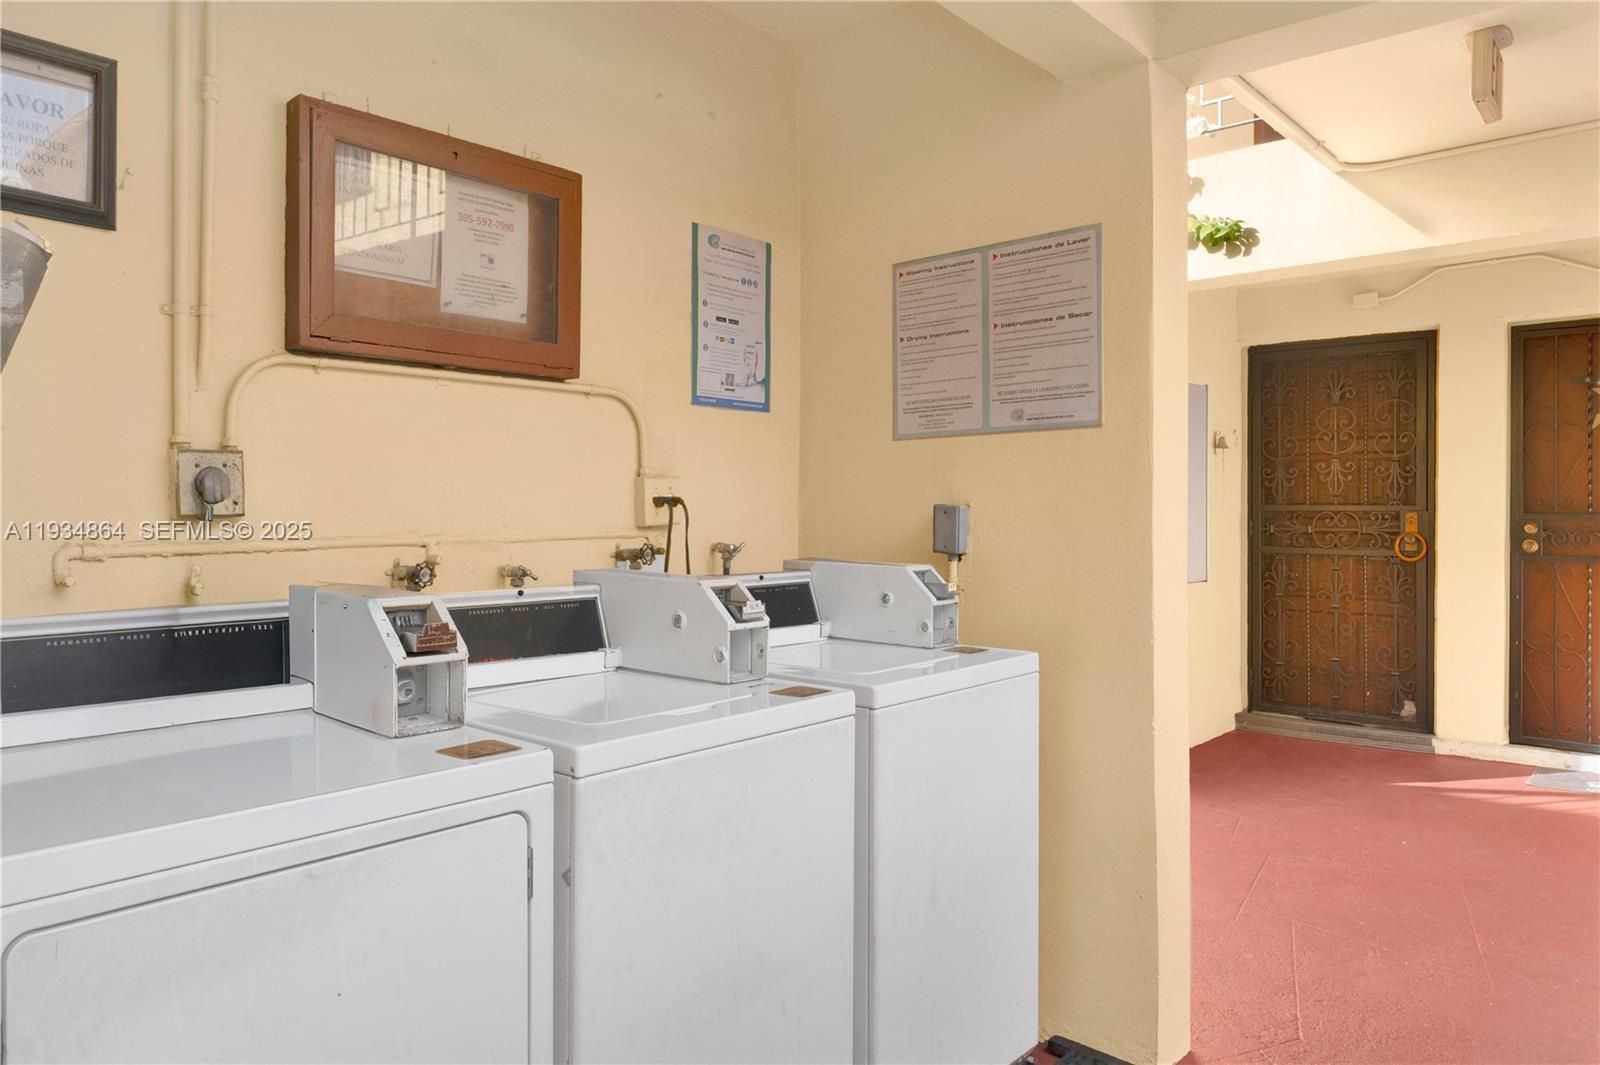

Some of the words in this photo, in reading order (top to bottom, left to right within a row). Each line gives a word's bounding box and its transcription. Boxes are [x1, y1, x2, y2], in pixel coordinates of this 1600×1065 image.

[16, 118, 50, 134] ROPA
[18, 135, 69, 153] PORQUE
[60, 158, 77, 170] DE
[456, 212, 516, 234] 305-592-7990
[1000, 245, 1053, 258] Instrucciones
[1054, 241, 1066, 249] de
[1067, 236, 1091, 247] Lavar
[905, 267, 933, 277] Washing
[1000, 316, 1054, 329] Instrucciones
[1067, 311, 1093, 320] Secar
[906, 335, 929, 344] Drying
[46, 637, 108, 647] PERMANENT
[120, 633, 151, 641] PRESS
